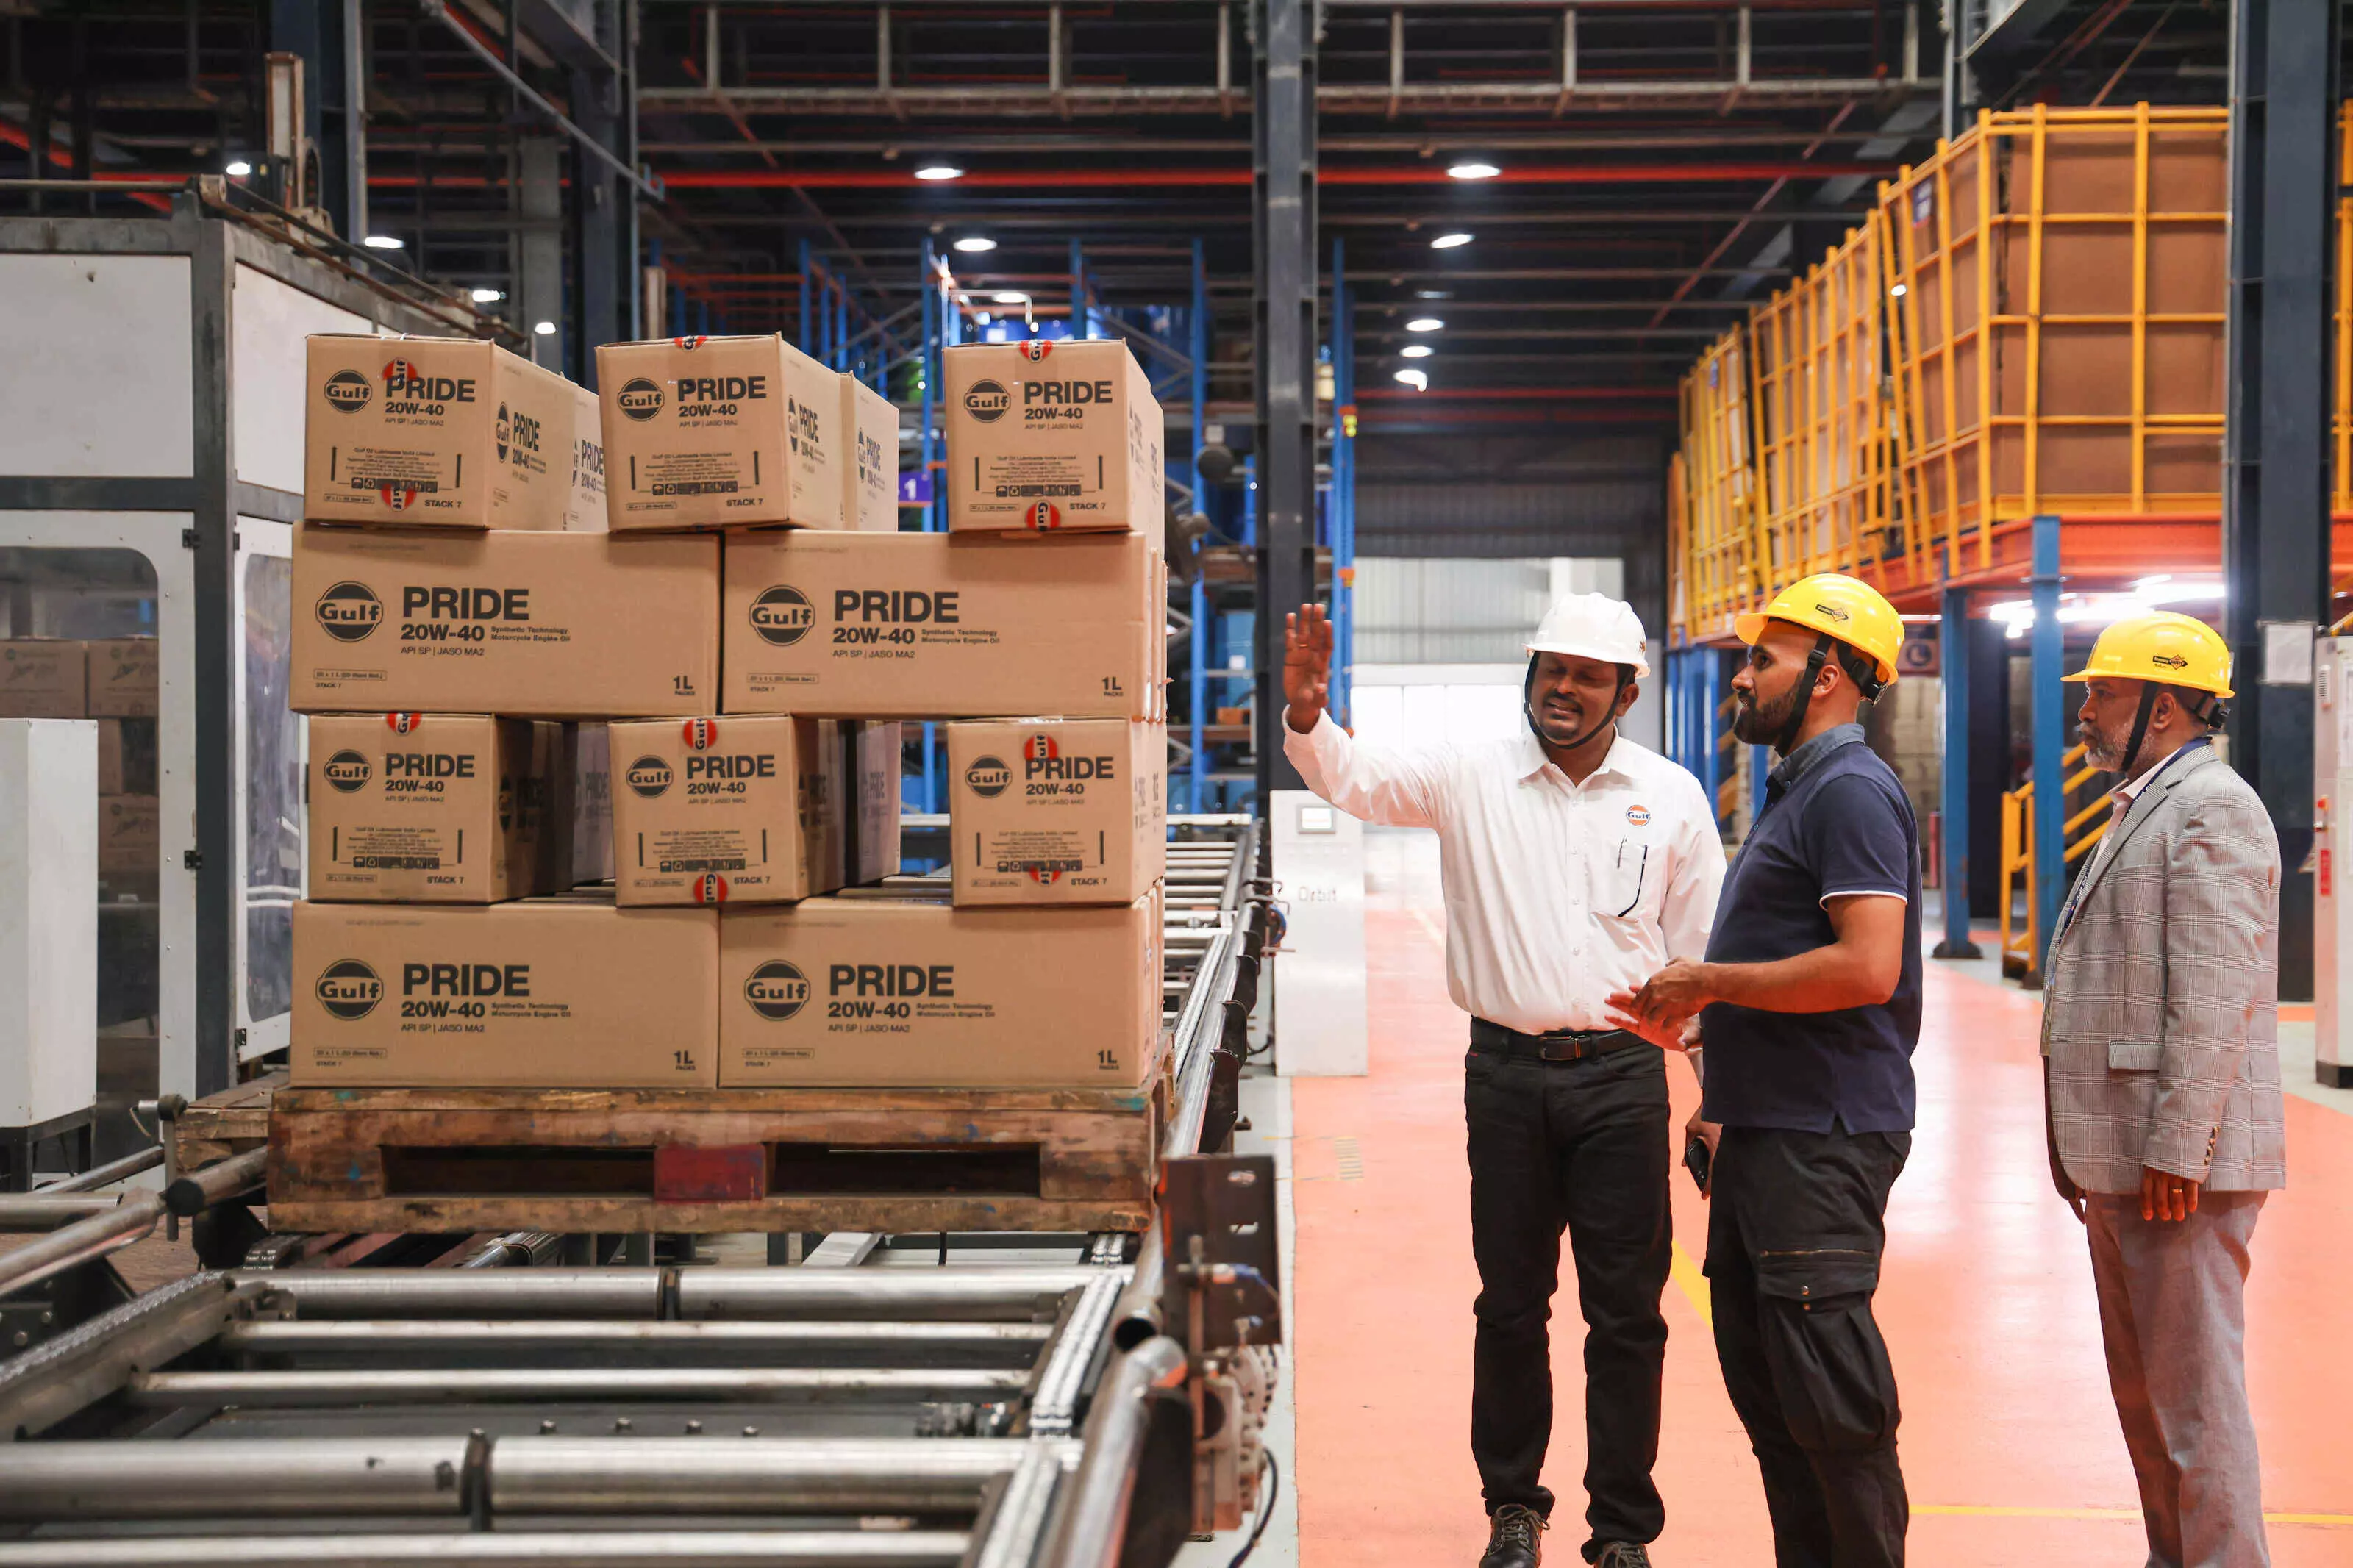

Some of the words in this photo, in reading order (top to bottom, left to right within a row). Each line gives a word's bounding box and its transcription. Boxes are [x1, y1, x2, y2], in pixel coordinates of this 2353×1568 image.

[326, 384, 370, 398] Gulf
[385, 376, 476, 402] PRIDE
[677, 376, 767, 401] PRIDE
[1024, 381, 1113, 404] PRIDE
[619, 393, 661, 407] Gulf
[966, 395, 1008, 407] Gulf
[385, 402, 444, 416] 20W-40
[679, 404, 738, 418] 20W-40
[1024, 407, 1083, 420] 20W-40
[513, 412, 540, 451] PRIDE
[582, 440, 604, 476] PRIDE
[904, 478, 916, 501] 1
[425, 499, 453, 508] STACK
[726, 498, 755, 507] STACK
[758, 498, 763, 506] 7
[318, 603, 380, 620] Gulf
[403, 586, 529, 621] PRIDE
[835, 590, 959, 623] PRIDE
[752, 607, 812, 625] Gulf
[401, 623, 485, 642] 20W-40
[832, 627, 915, 644] 20W-40
[437, 647, 463, 656] JASO
[464, 648, 485, 656] MA2
[849, 650, 862, 658] SP
[868, 650, 893, 658] JASO
[896, 651, 915, 659] MA2
[326, 765, 369, 778] Gulf
[385, 753, 475, 778] PRIDE
[687, 754, 775, 779] PRIDE
[1026, 756, 1114, 780] PRIDE
[628, 772, 671, 783] Gulf
[967, 771, 1010, 783] Gulf
[385, 779, 444, 792] 20W-40
[688, 781, 746, 795] 20W-40
[1026, 783, 1084, 795] 20W-40
[1627, 812, 1651, 820] Gulf
[427, 876, 456, 884] STACK
[706, 874, 716, 901] Gul
[734, 876, 762, 884] STACK
[765, 876, 771, 884] 7
[403, 963, 530, 997] PRIDE
[829, 964, 954, 998] PRIDE
[318, 981, 380, 999] Gulf
[748, 982, 807, 999] Gulf
[401, 1000, 485, 1018] 20W-40
[828, 1002, 911, 1018] 20W-40
[401, 1023, 417, 1032] API
[418, 1023, 432, 1032] SP
[438, 1024, 462, 1033] JASO
[465, 1025, 485, 1033] MA2
[828, 1024, 843, 1032] API
[845, 1024, 857, 1032] SP
[864, 1024, 888, 1033] JASO
[890, 1025, 910, 1033] MA2
